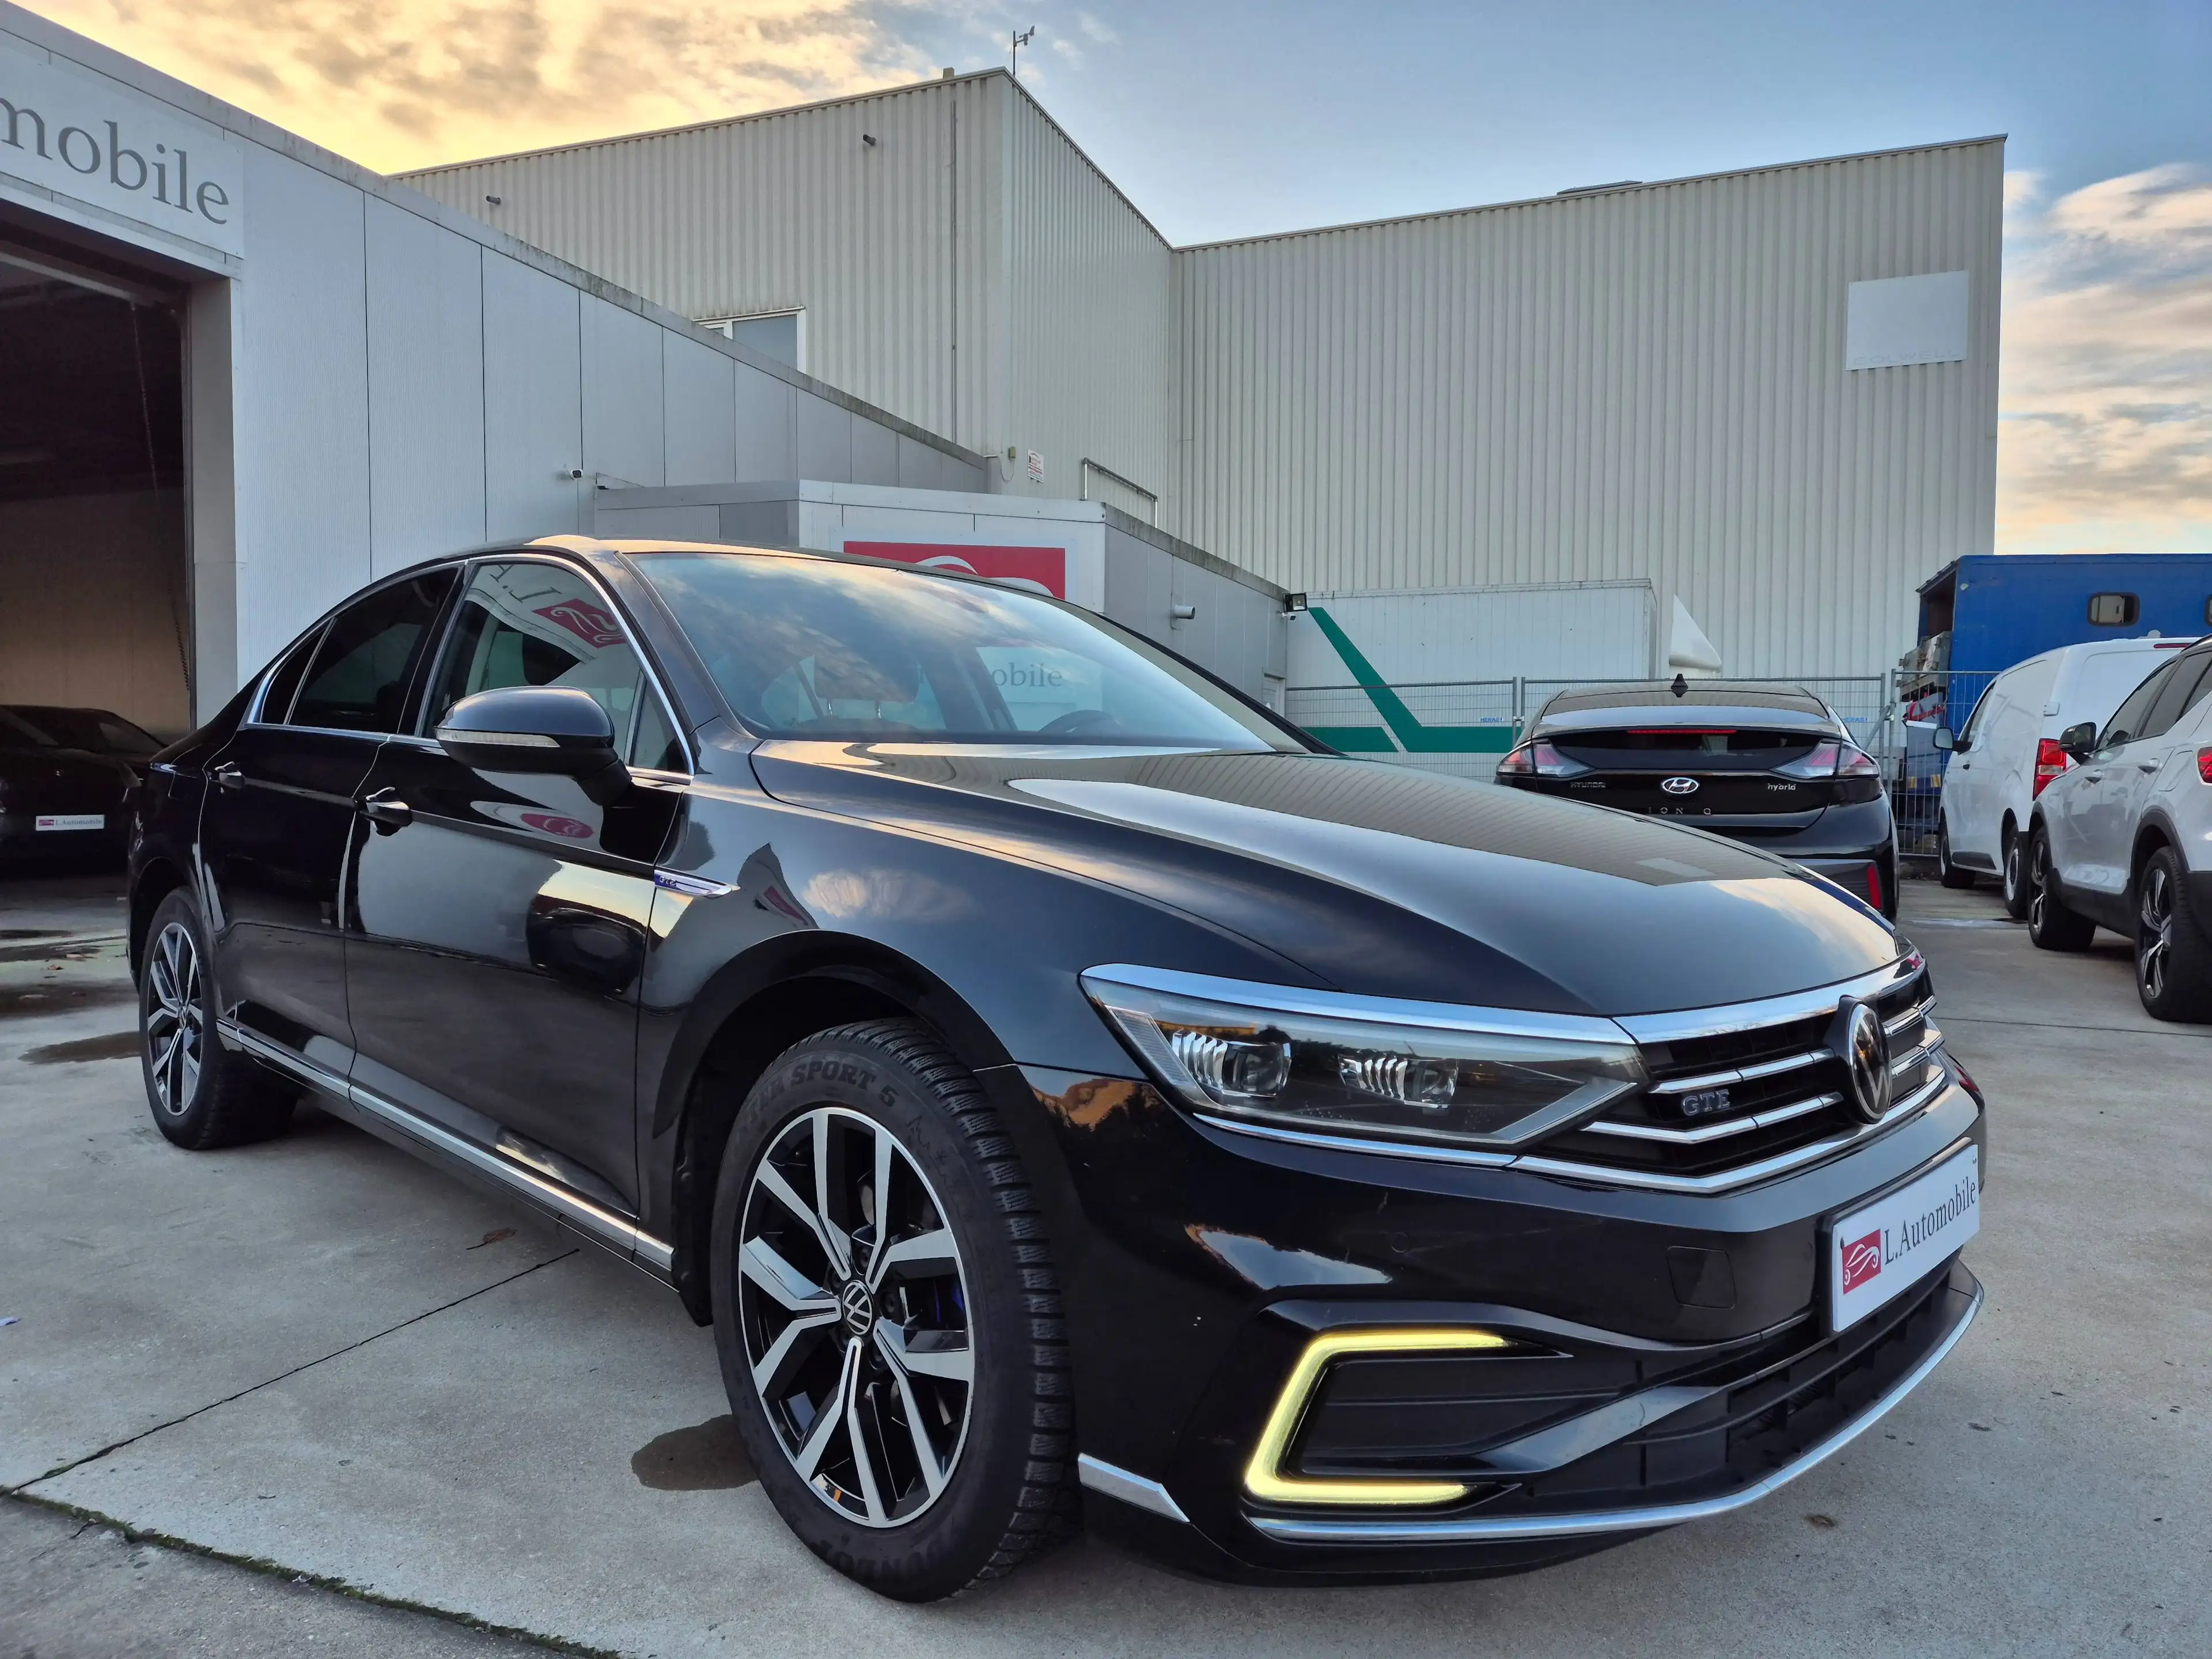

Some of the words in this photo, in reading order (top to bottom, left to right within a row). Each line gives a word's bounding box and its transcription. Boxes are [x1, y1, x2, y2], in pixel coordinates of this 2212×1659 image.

[1853, 349, 1960, 366] COLWELL
[1767, 783, 1797, 791] hybrid
[1648, 806, 1712, 815] IONQ
[790, 1060, 877, 1091] SPORT
[878, 1084, 900, 1108] 5
[1682, 1088, 1731, 1116] GTE
[1884, 1176, 1976, 1266] L.Automobile
